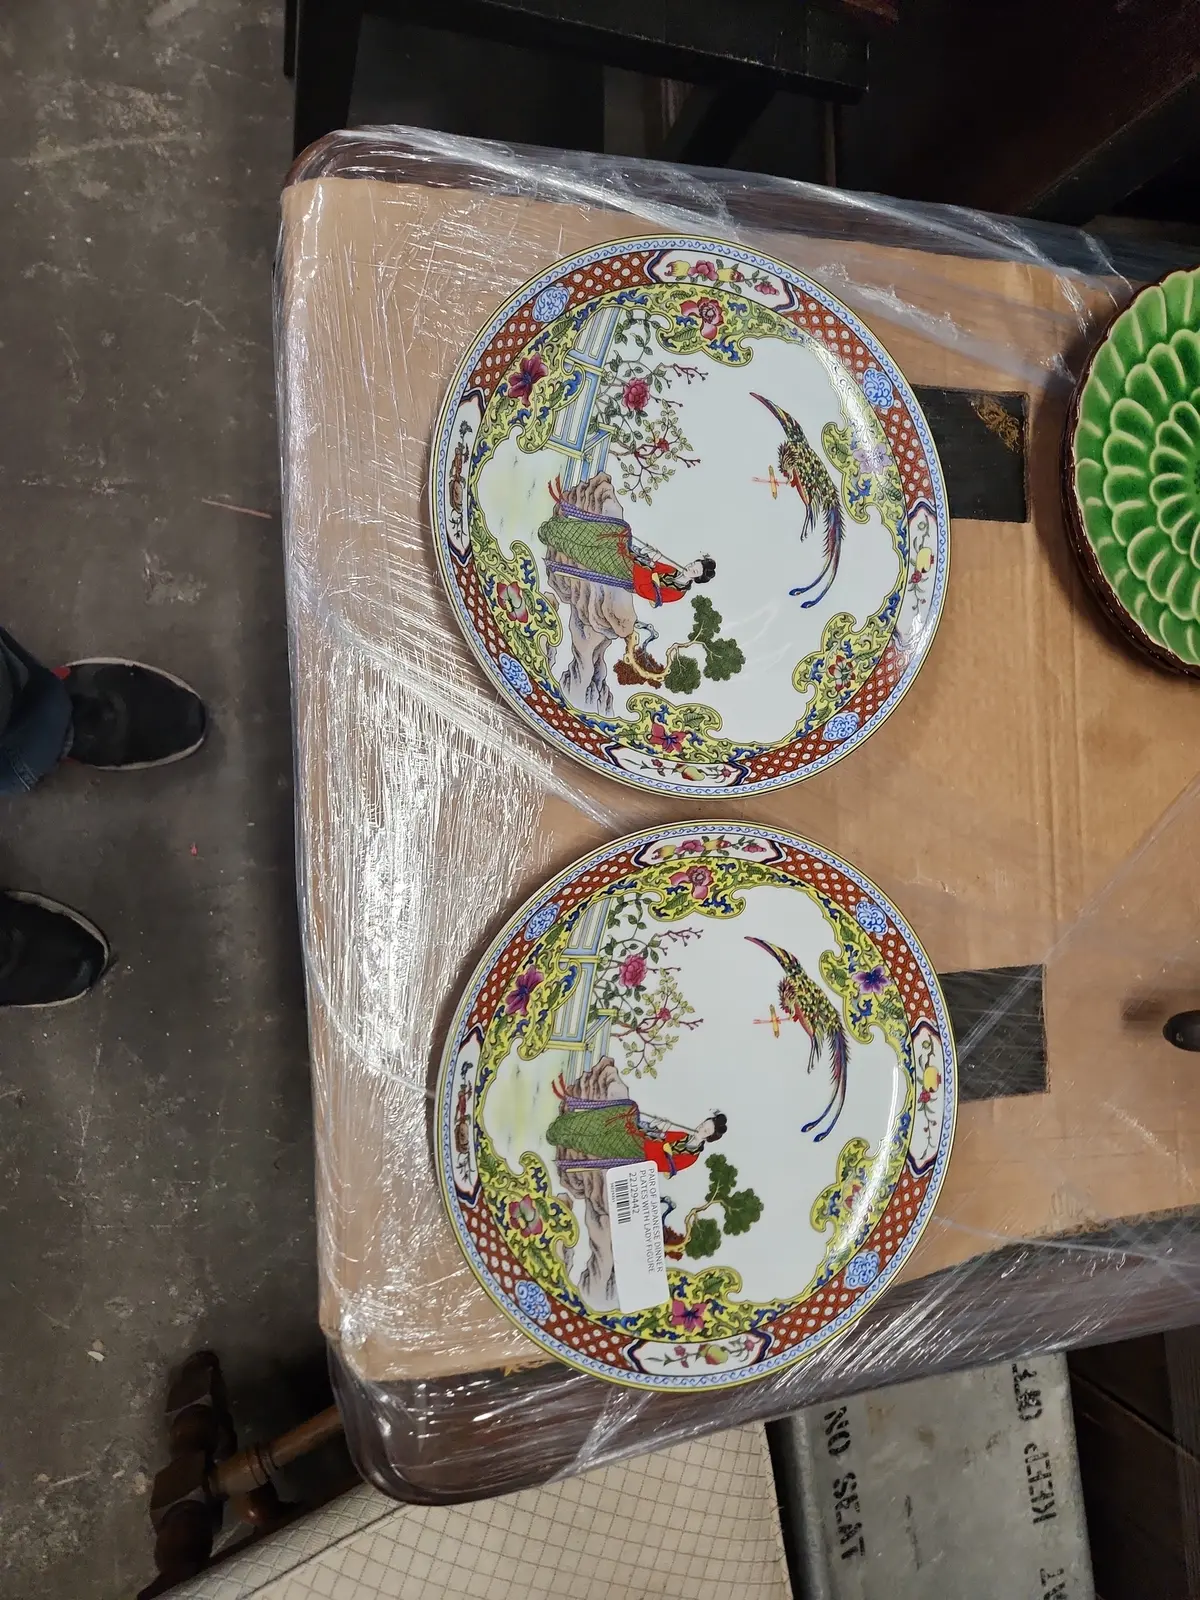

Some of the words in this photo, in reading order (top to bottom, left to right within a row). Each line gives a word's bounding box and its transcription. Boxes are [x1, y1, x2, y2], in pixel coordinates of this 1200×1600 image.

[640, 1170, 648, 1199] PLATES
[649, 1188, 657, 1199] OF
[642, 1199, 651, 1221] WITH
[651, 1201, 660, 1240] JAPANESE
[644, 1222, 653, 1242] LADY
[654, 1242, 663, 1272] DINNER
[824, 1405, 851, 1456] NO
[1023, 1442, 1057, 1524] KEEP
[832, 1471, 865, 1560] SEAT
